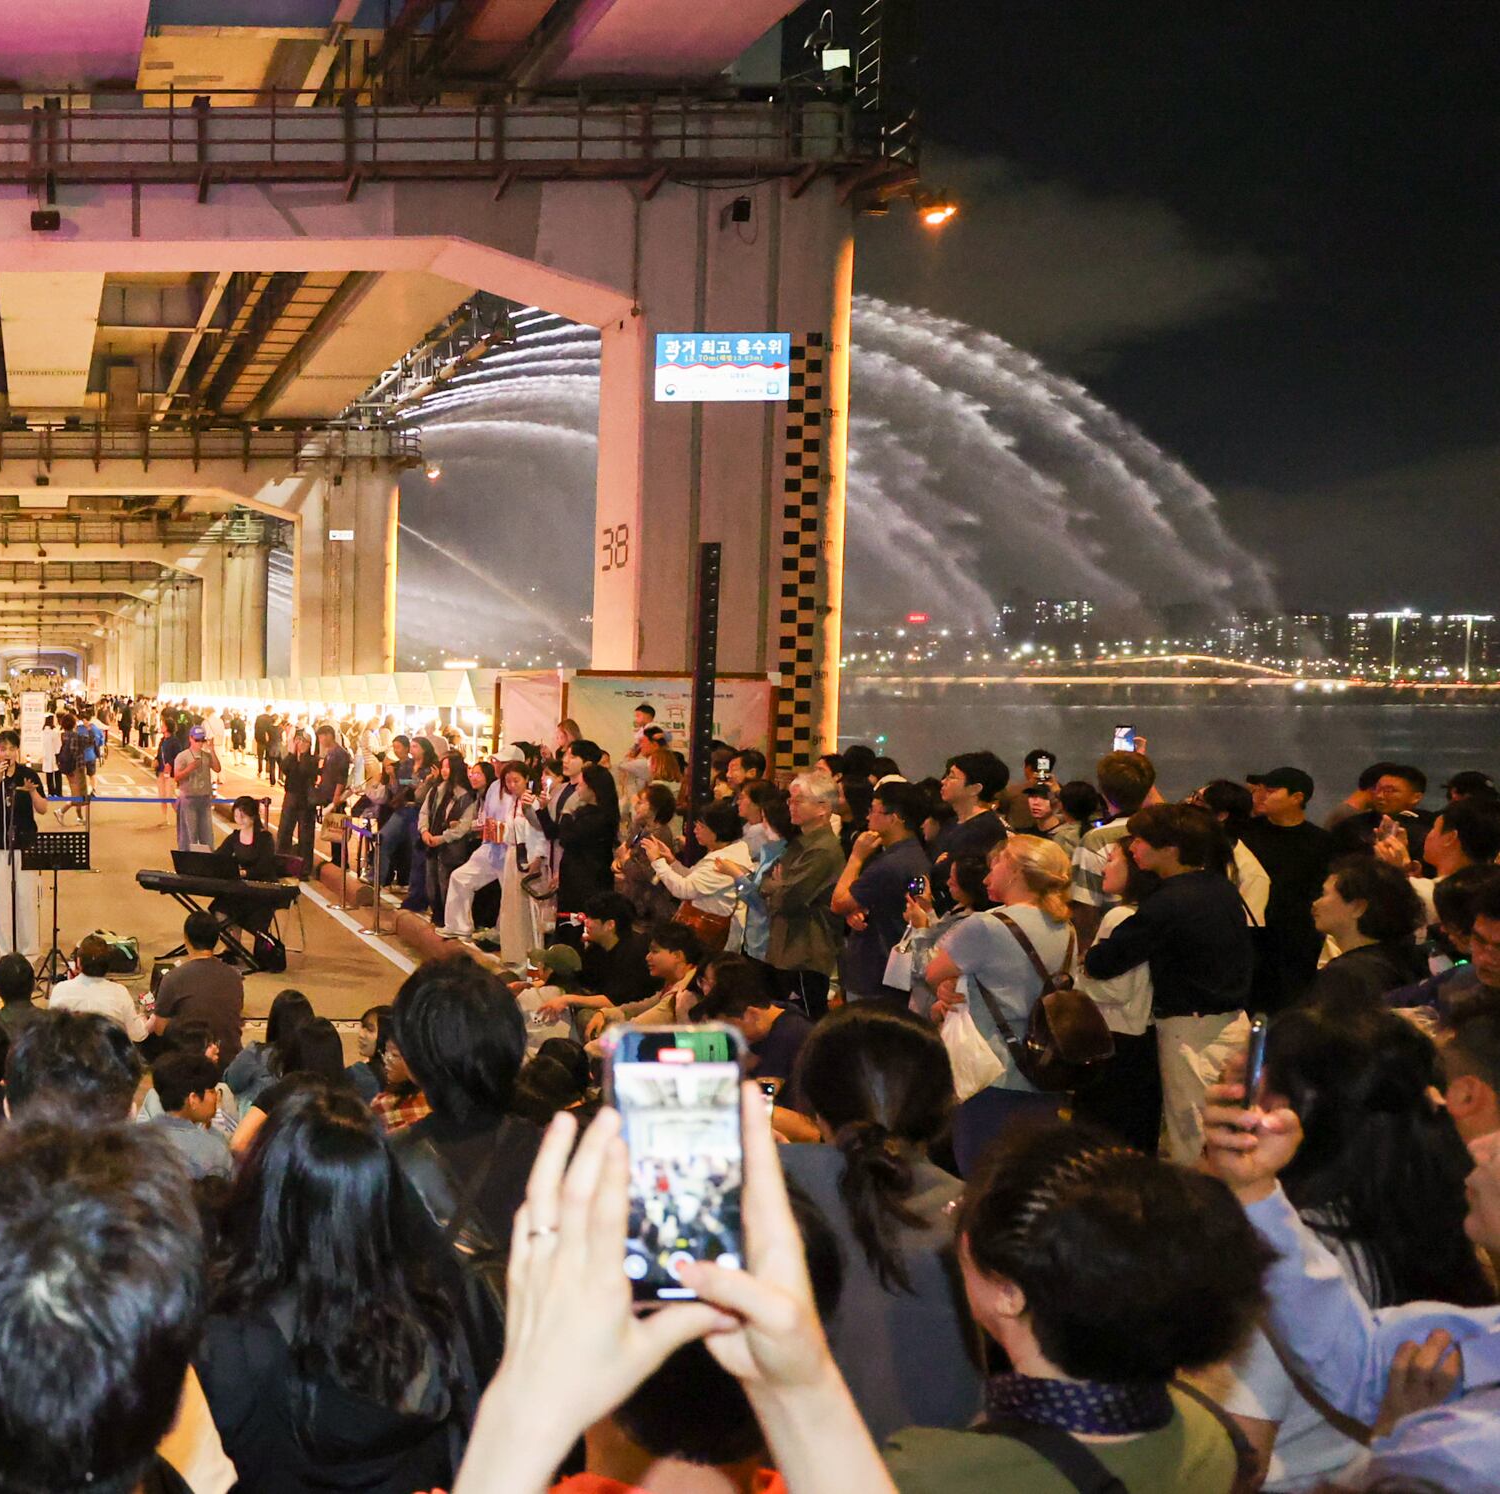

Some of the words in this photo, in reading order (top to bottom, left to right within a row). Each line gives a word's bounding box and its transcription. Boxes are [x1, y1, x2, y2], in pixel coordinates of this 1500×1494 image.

[665, 339, 696, 357] 과거
[701, 339, 731, 355] 최고
[736, 339, 783, 356] 홍수위
[602, 523, 629, 572] 38
